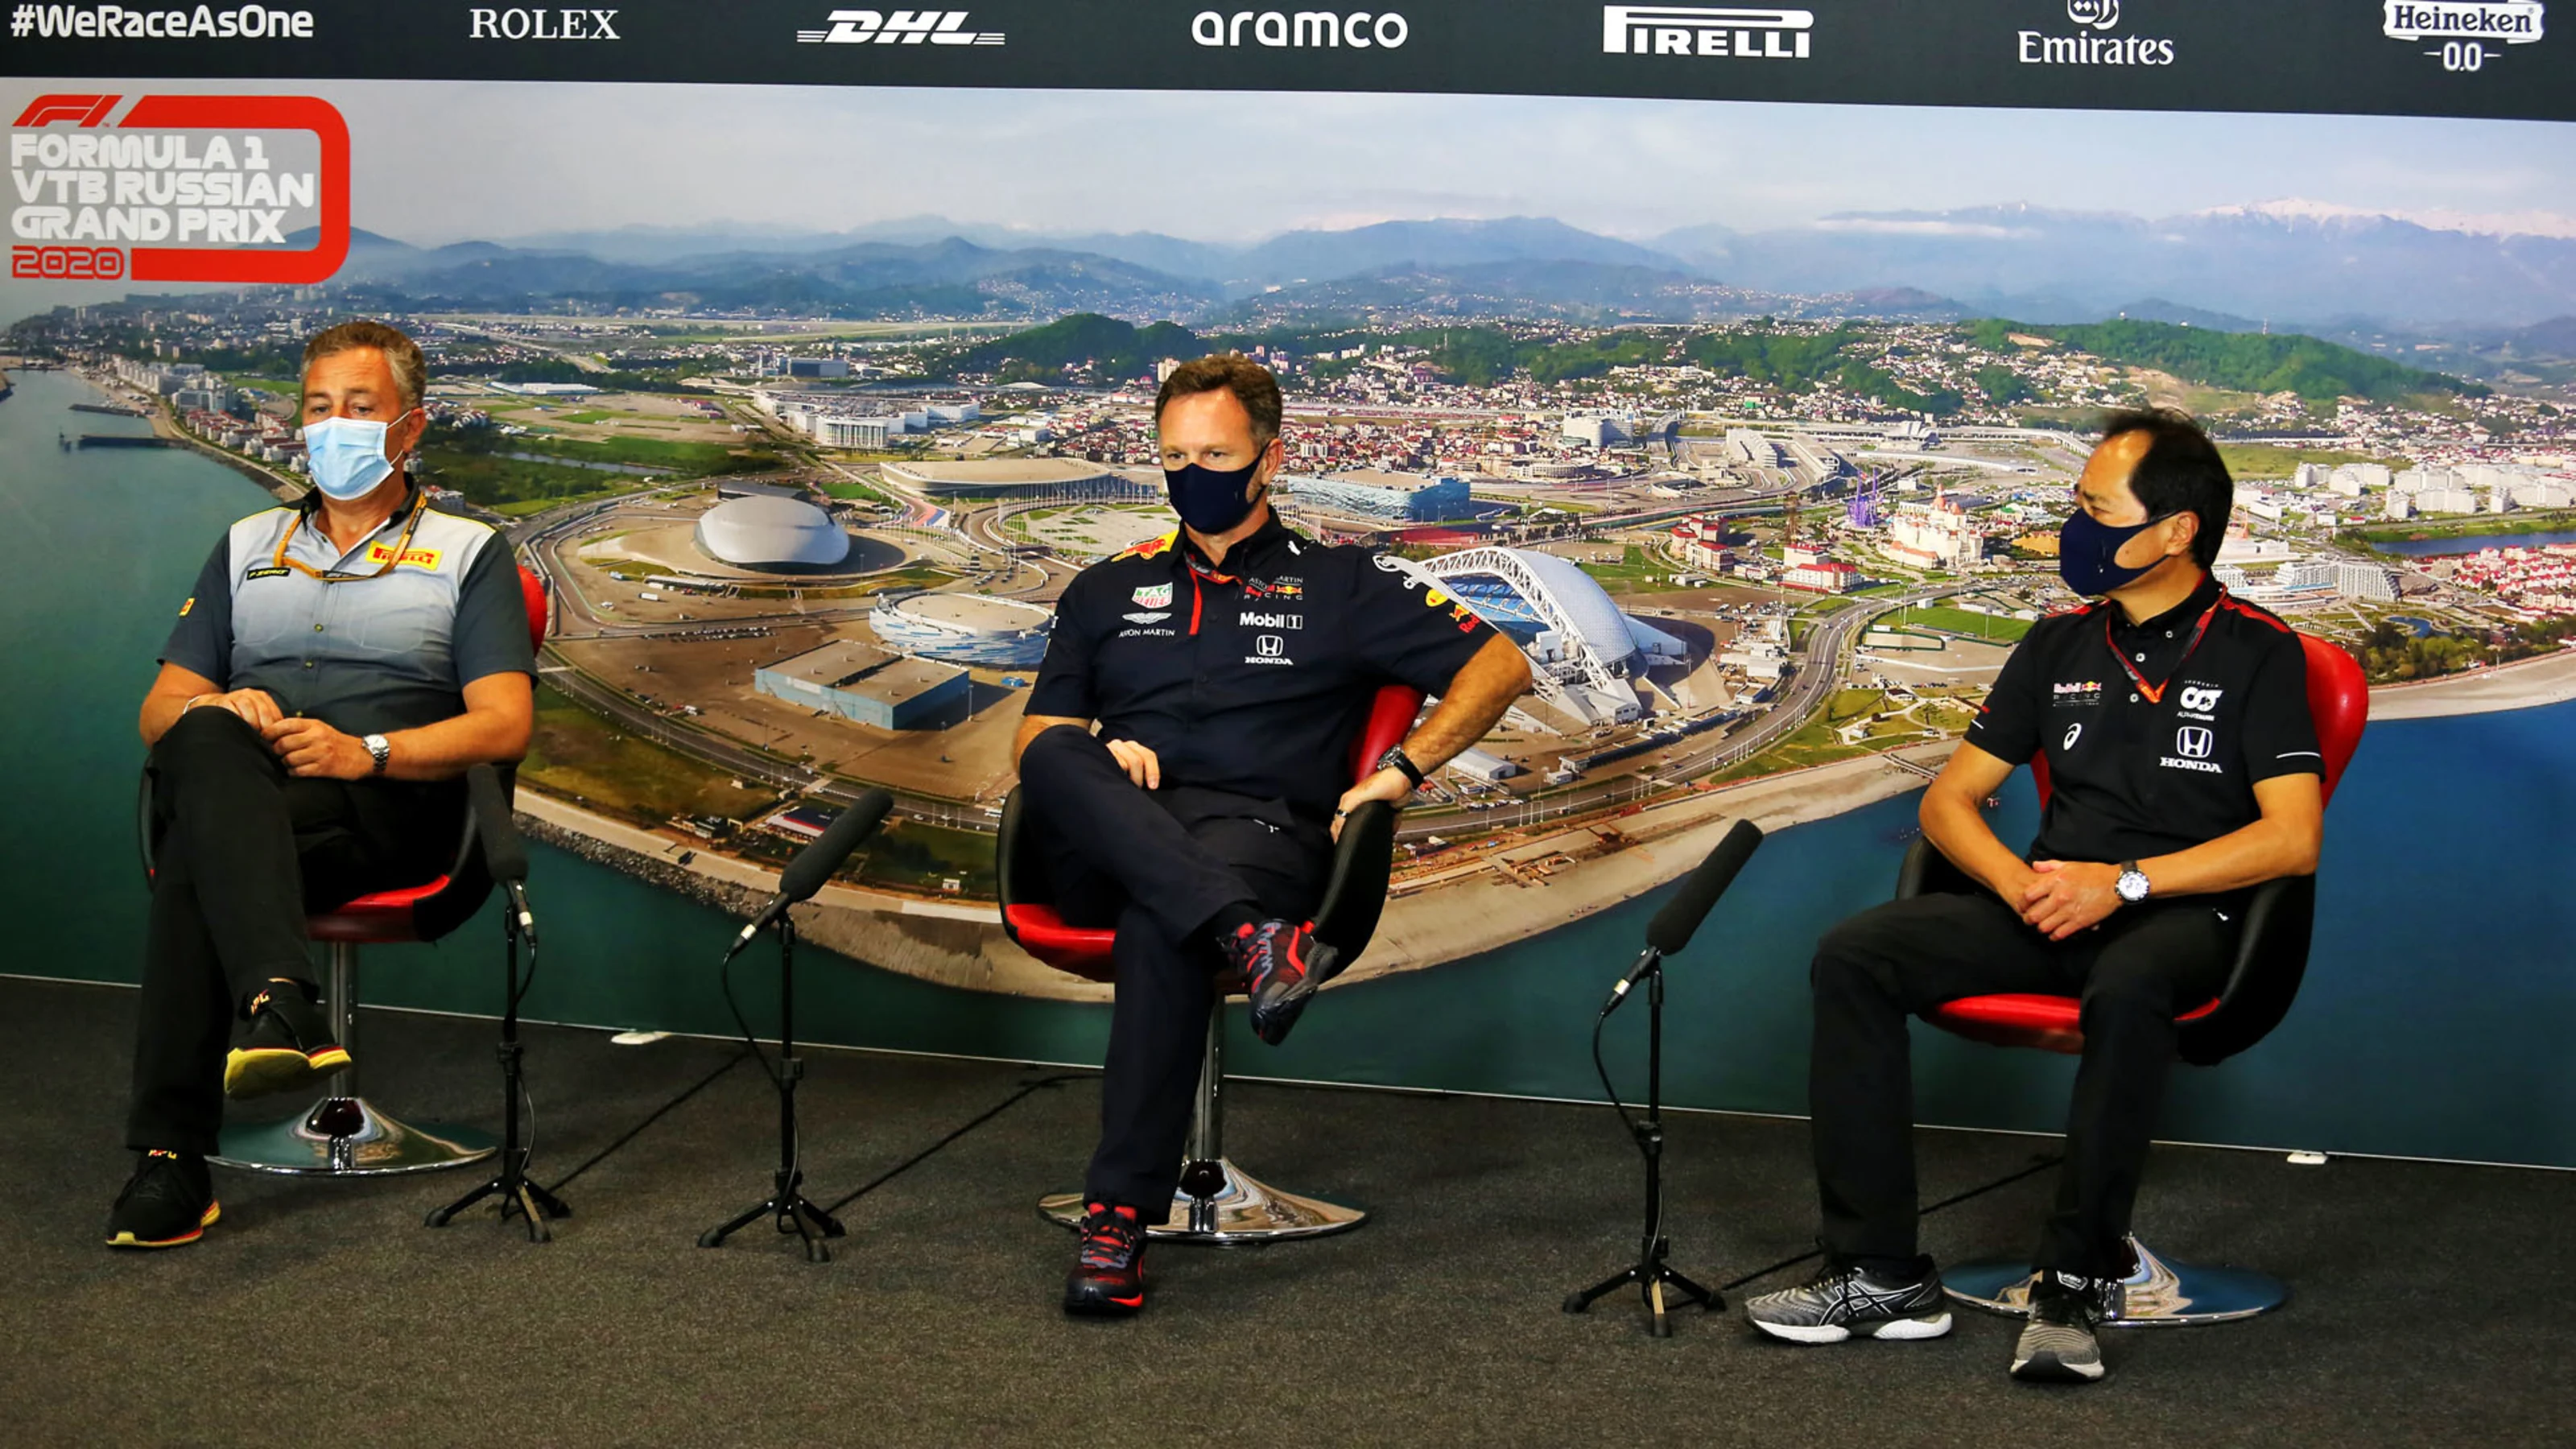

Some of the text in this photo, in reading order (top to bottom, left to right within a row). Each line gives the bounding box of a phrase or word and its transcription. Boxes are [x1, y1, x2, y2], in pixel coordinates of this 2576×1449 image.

[10, 4, 314, 39] #WeRaceAsOne
[469, 7, 621, 40] ROLEX
[824, 10, 971, 45] DHL
[1191, 10, 1409, 49] aramco
[1603, 5, 1814, 58] PIRELLI
[2393, 5, 2533, 33] Heineken
[2017, 30, 2175, 65] Emirates
[2442, 41, 2483, 72] 0.0
[10, 133, 270, 171] FORMULA 1
[11, 169, 315, 208] VTB RUSSIAN
[10, 205, 287, 244] GRAND PRIX
[11, 245, 125, 280] 2020
[1142, 628, 1176, 637] MARTIN
[1240, 612, 1286, 628] Mobil
[1245, 656, 1294, 666] HONDA
[2159, 757, 2223, 774] HONDA
